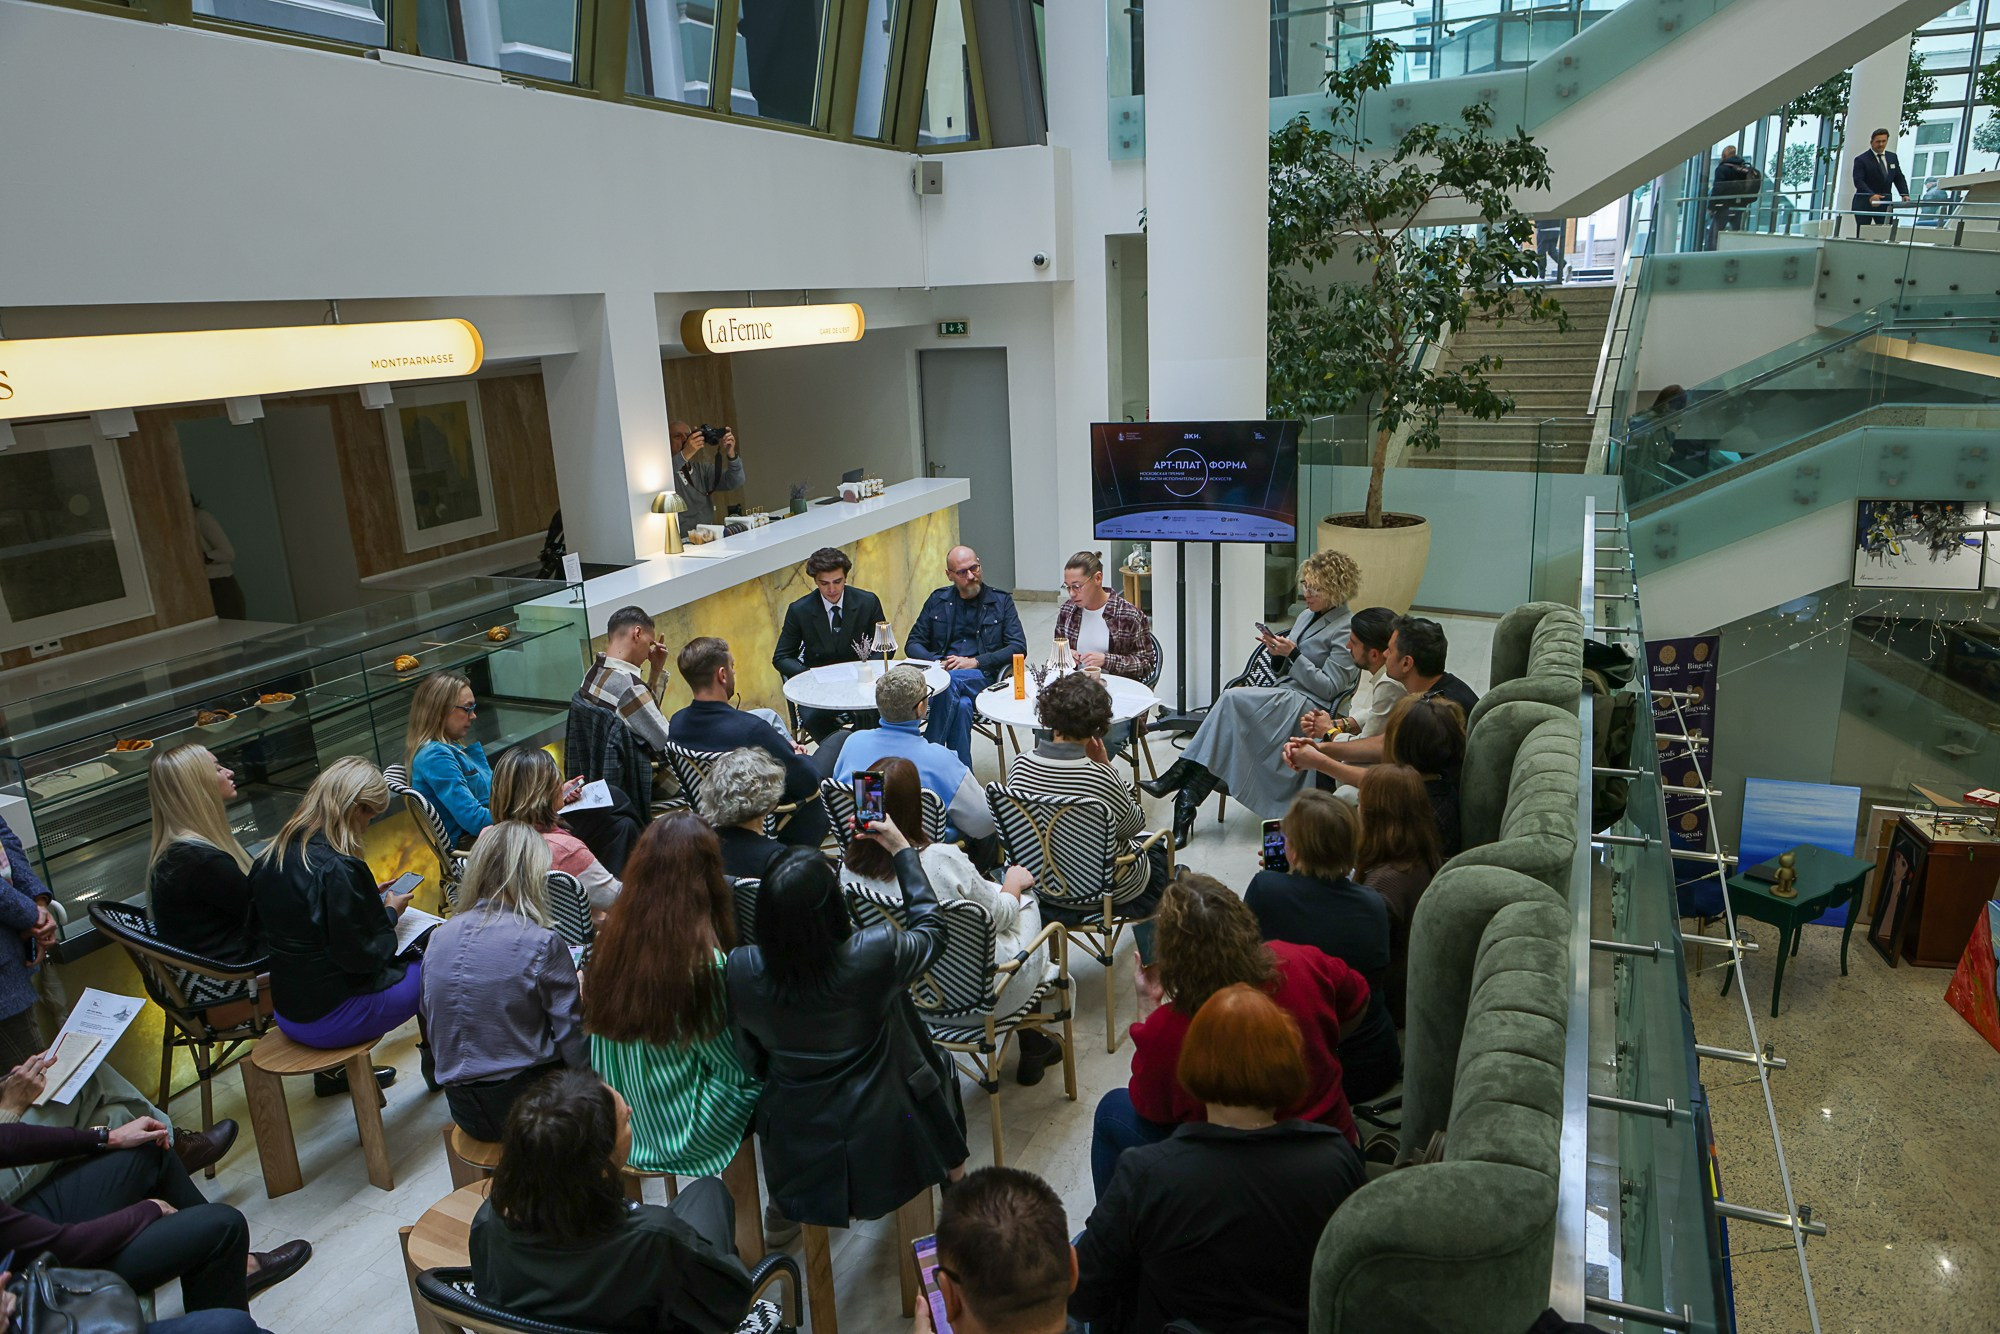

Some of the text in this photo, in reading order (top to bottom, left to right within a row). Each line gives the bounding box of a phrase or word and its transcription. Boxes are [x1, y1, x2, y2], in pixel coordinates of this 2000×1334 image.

[708, 317, 773, 344] La Ferme
[370, 353, 455, 370] MONTPARNASSE
[1153, 460, 1248, 470] АРТ-ПЛАТ ФОРМА
